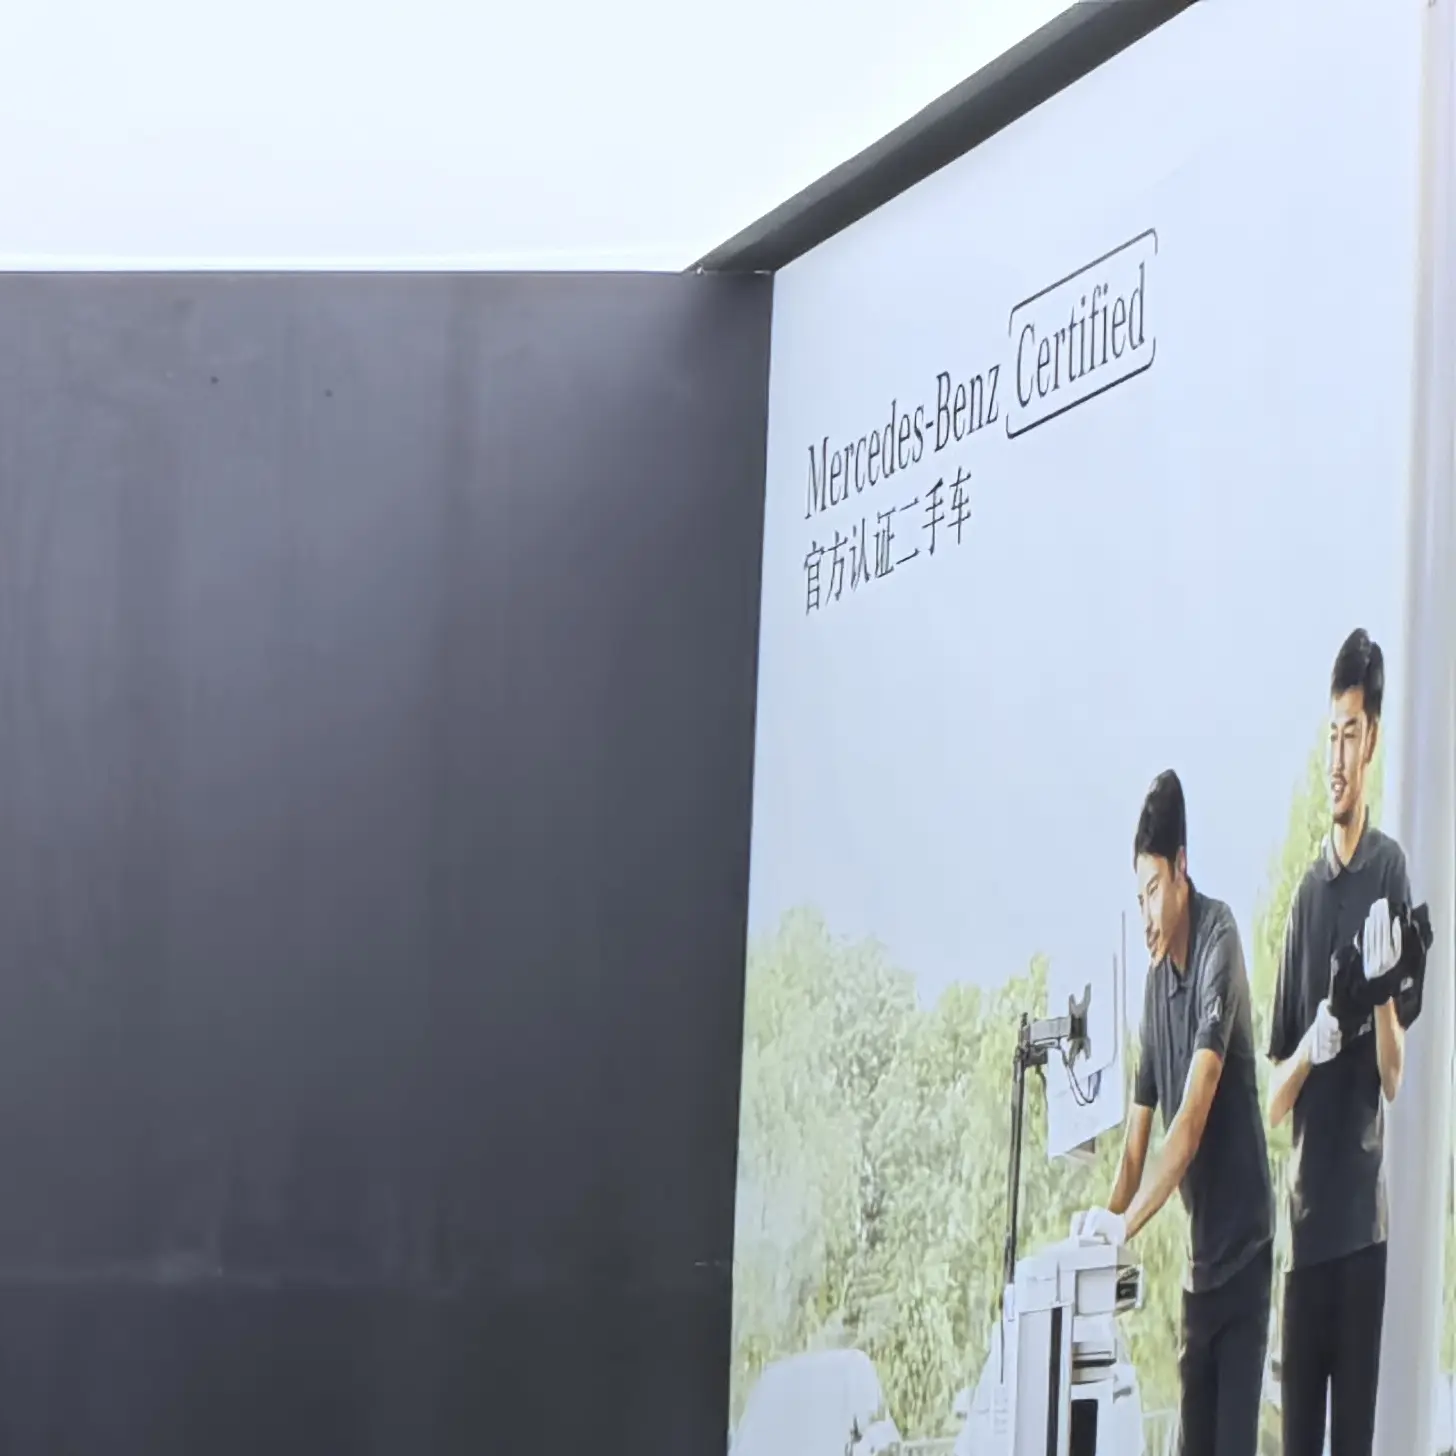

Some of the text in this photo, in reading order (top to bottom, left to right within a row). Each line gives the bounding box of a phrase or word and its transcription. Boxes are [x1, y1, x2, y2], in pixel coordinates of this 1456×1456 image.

[805, 262, 1145, 519] Mercedes-Benz Certified
[804, 467, 971, 615] 官方认证二手车
